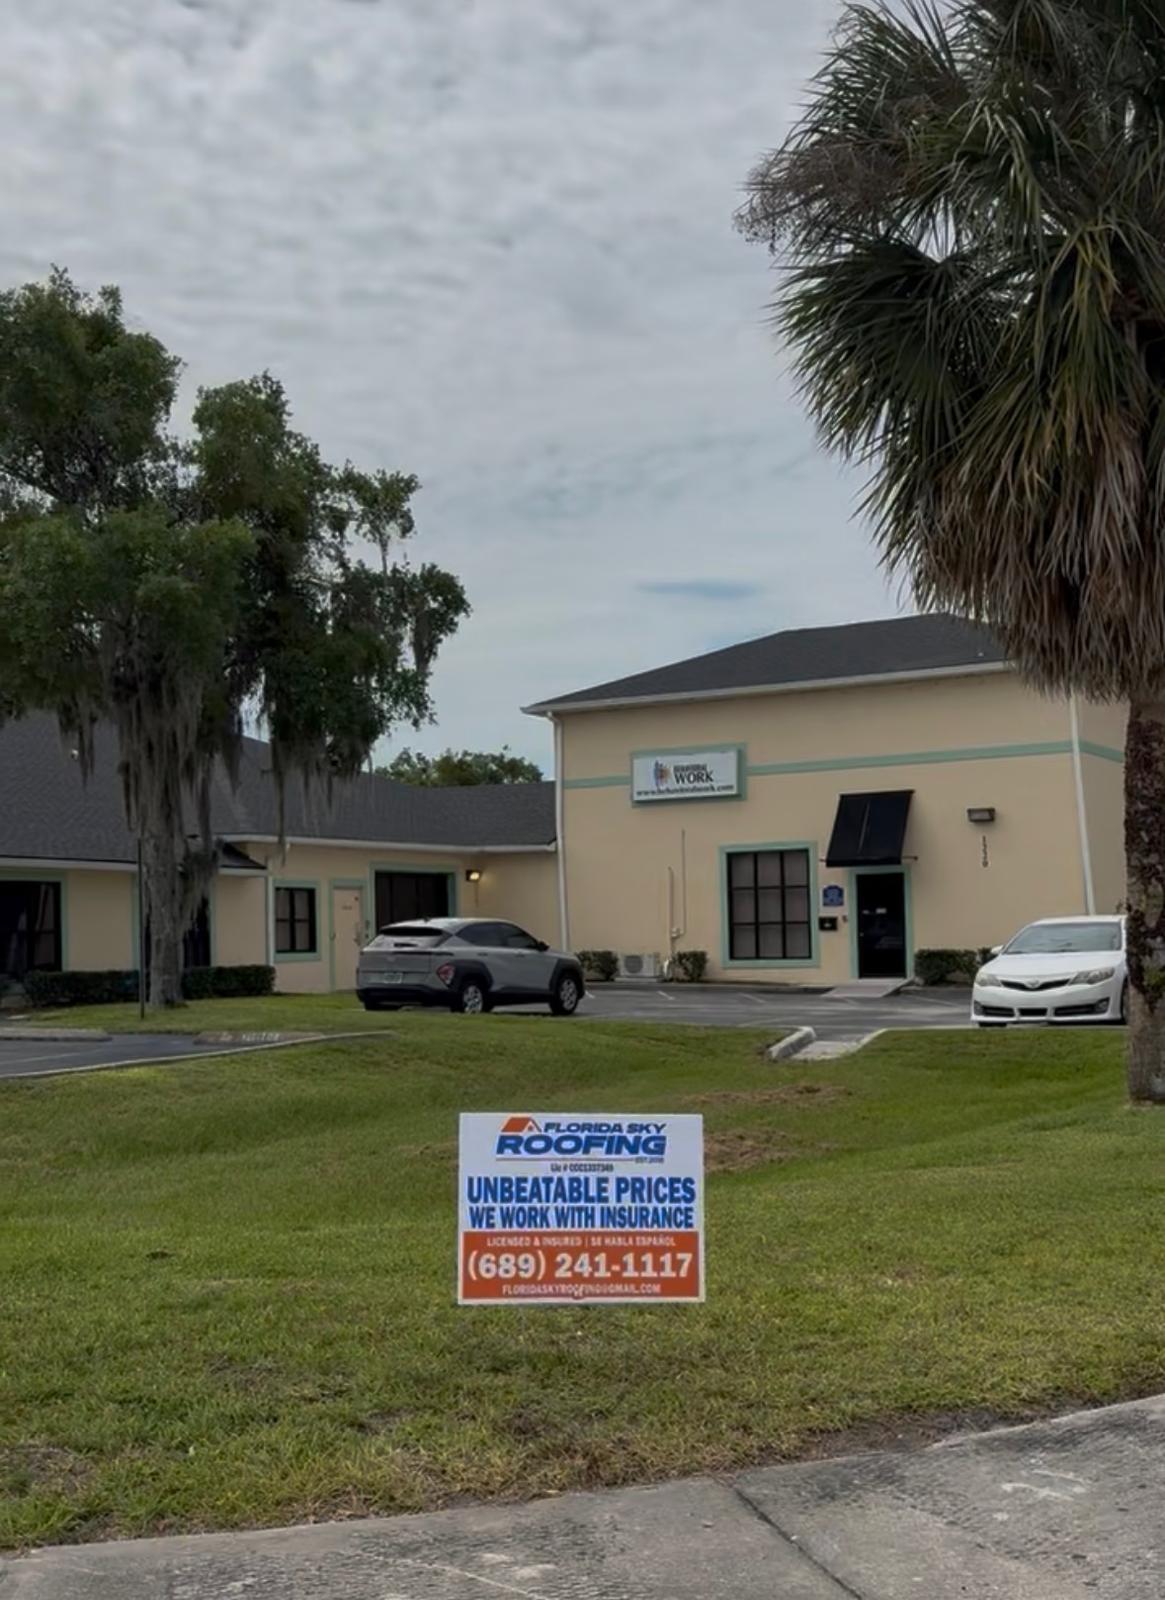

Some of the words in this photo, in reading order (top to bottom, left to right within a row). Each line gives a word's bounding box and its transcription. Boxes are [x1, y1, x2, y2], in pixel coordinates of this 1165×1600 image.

[674, 770, 714, 784] WORK
[544, 1122, 622, 1134] FLORIDA
[626, 1122, 667, 1134] SKY
[496, 1135, 667, 1156] ROOFING
[467, 1176, 610, 1203] UNBEATABLE
[616, 1177, 696, 1203] PRICES
[469, 1207, 495, 1228] WE
[500, 1207, 550, 1228] WORK
[555, 1207, 596, 1228] WITH
[601, 1207, 694, 1229] INSURANCE
[487, 1237, 530, 1247] LICENSED
[533, 1237, 540, 1247] &
[542, 1237, 582, 1247] INSURED
[591, 1237, 602, 1247] SE
[604, 1237, 633, 1247] HABLA
[635, 1235, 676, 1247] ESPAÑOL
[467, 1250, 546, 1281] (689)
[555, 1252, 693, 1279] 241-1117
